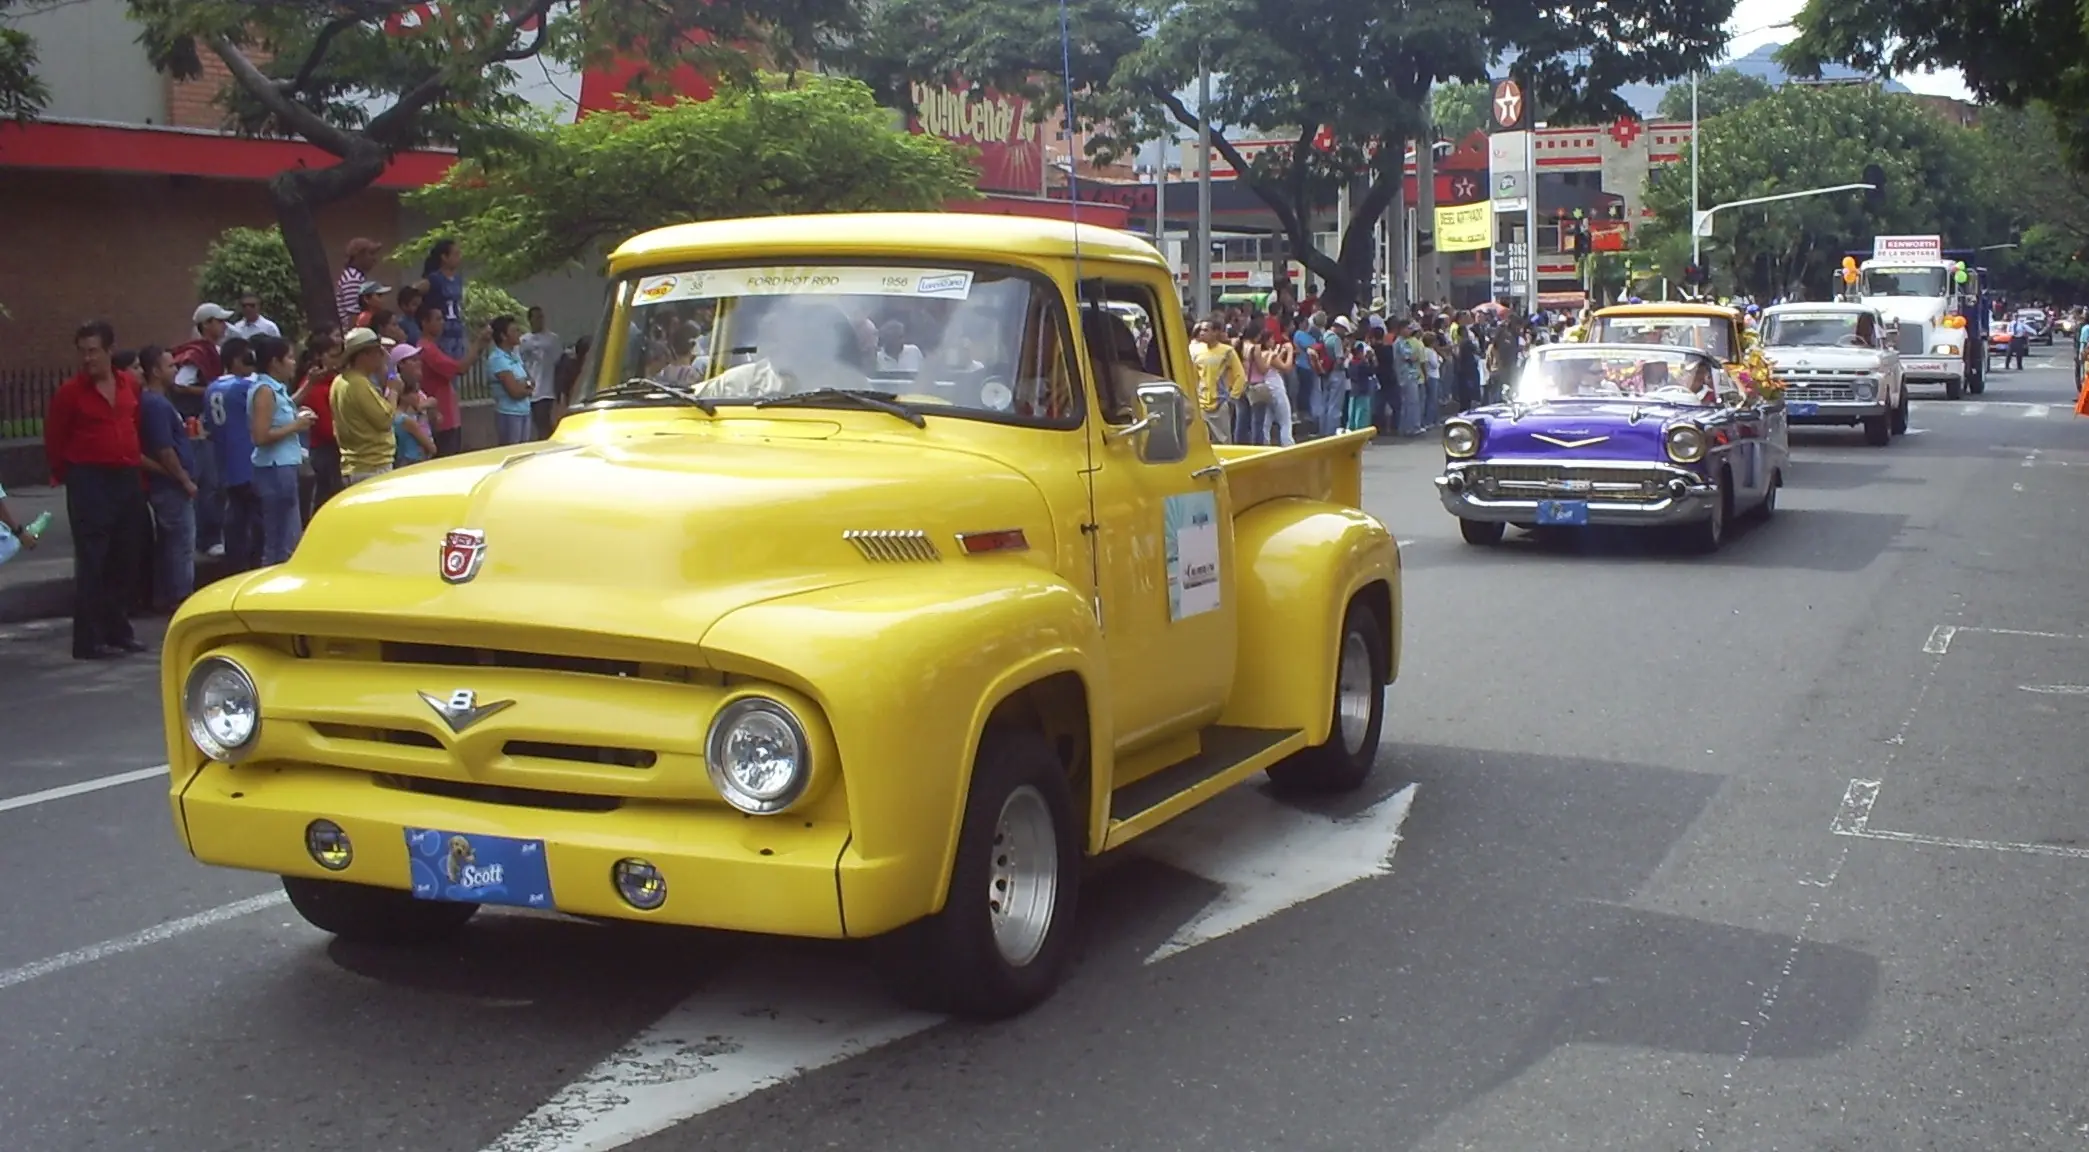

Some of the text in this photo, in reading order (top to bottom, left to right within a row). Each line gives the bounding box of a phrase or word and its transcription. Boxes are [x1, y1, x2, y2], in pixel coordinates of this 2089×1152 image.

[747, 276, 840, 287] FORD HOT ROD
[882, 276, 909, 287] 1956
[210, 392, 226, 426] 8
[462, 863, 504, 888] Scott
